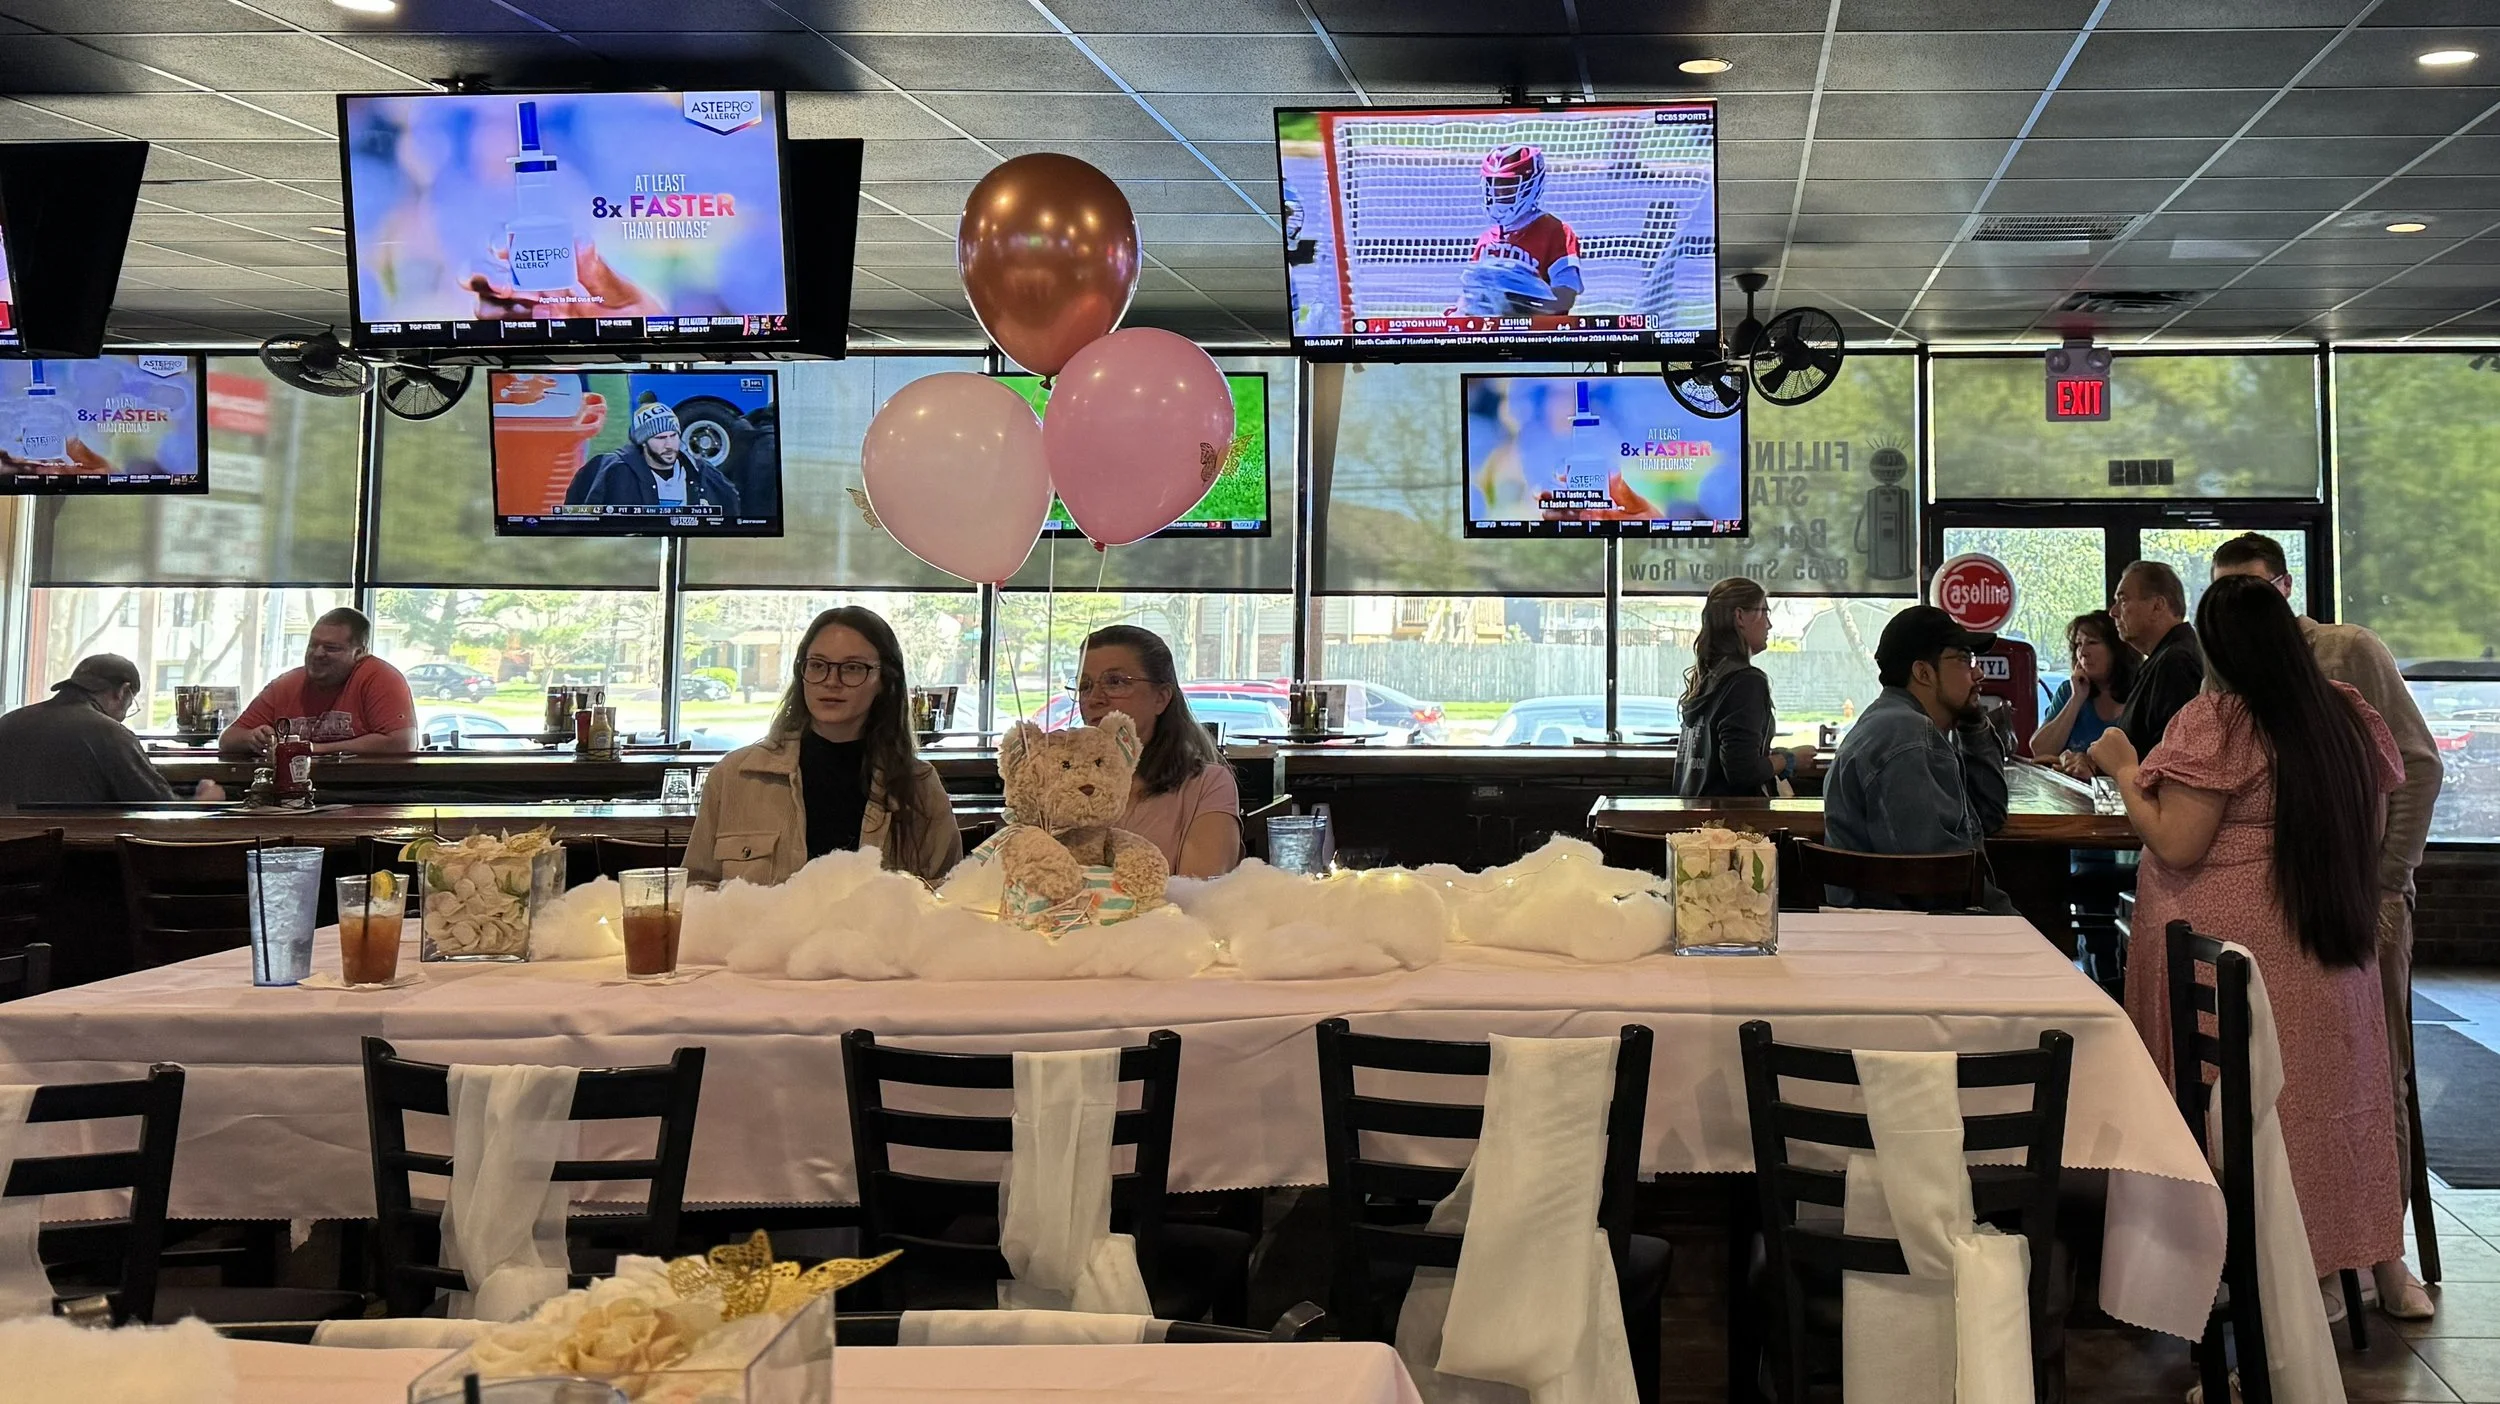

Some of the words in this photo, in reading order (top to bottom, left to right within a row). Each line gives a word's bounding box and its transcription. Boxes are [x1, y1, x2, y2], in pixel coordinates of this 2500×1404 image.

[691, 101, 753, 113] ASTEPRO
[704, 112, 741, 120] ALLERGY
[1678, 113, 1707, 121] SPORTS
[635, 174, 649, 192] AT
[651, 174, 687, 192] LEAST
[592, 196, 623, 219] 8x
[629, 193, 736, 218] FASTER
[622, 221, 654, 240] THAN
[656, 220, 711, 240] FLONASE
[514, 247, 570, 262] ASTEPRO
[515, 261, 550, 270] ALLERGY
[599, 319, 613, 327] TOP
[1389, 319, 1425, 328] BOSTON
[1425, 319, 1448, 328] UNIV
[1466, 320, 1475, 329] 4
[1499, 317, 1532, 326] LEHIGH
[1579, 317, 1586, 328] 3
[1594, 318, 1611, 327] 1ST
[370, 323, 402, 333] ESPN
[408, 323, 422, 331] TOP
[1660, 337, 1696, 345] NETWORK
[2057, 381, 2103, 415] EXIT
[77, 408, 98, 422] 8x
[102, 408, 168, 422] FASTER
[1648, 428, 1658, 440] AT
[1659, 428, 1681, 440] LEAST
[1620, 442, 1640, 457] 8x
[1644, 441, 1711, 457] FASTER
[1639, 458, 1660, 470] THAN
[1660, 458, 1696, 470] FLONASE
[1570, 474, 1606, 484] ASTEPRO
[1942, 574, 2010, 614] Gasoline
